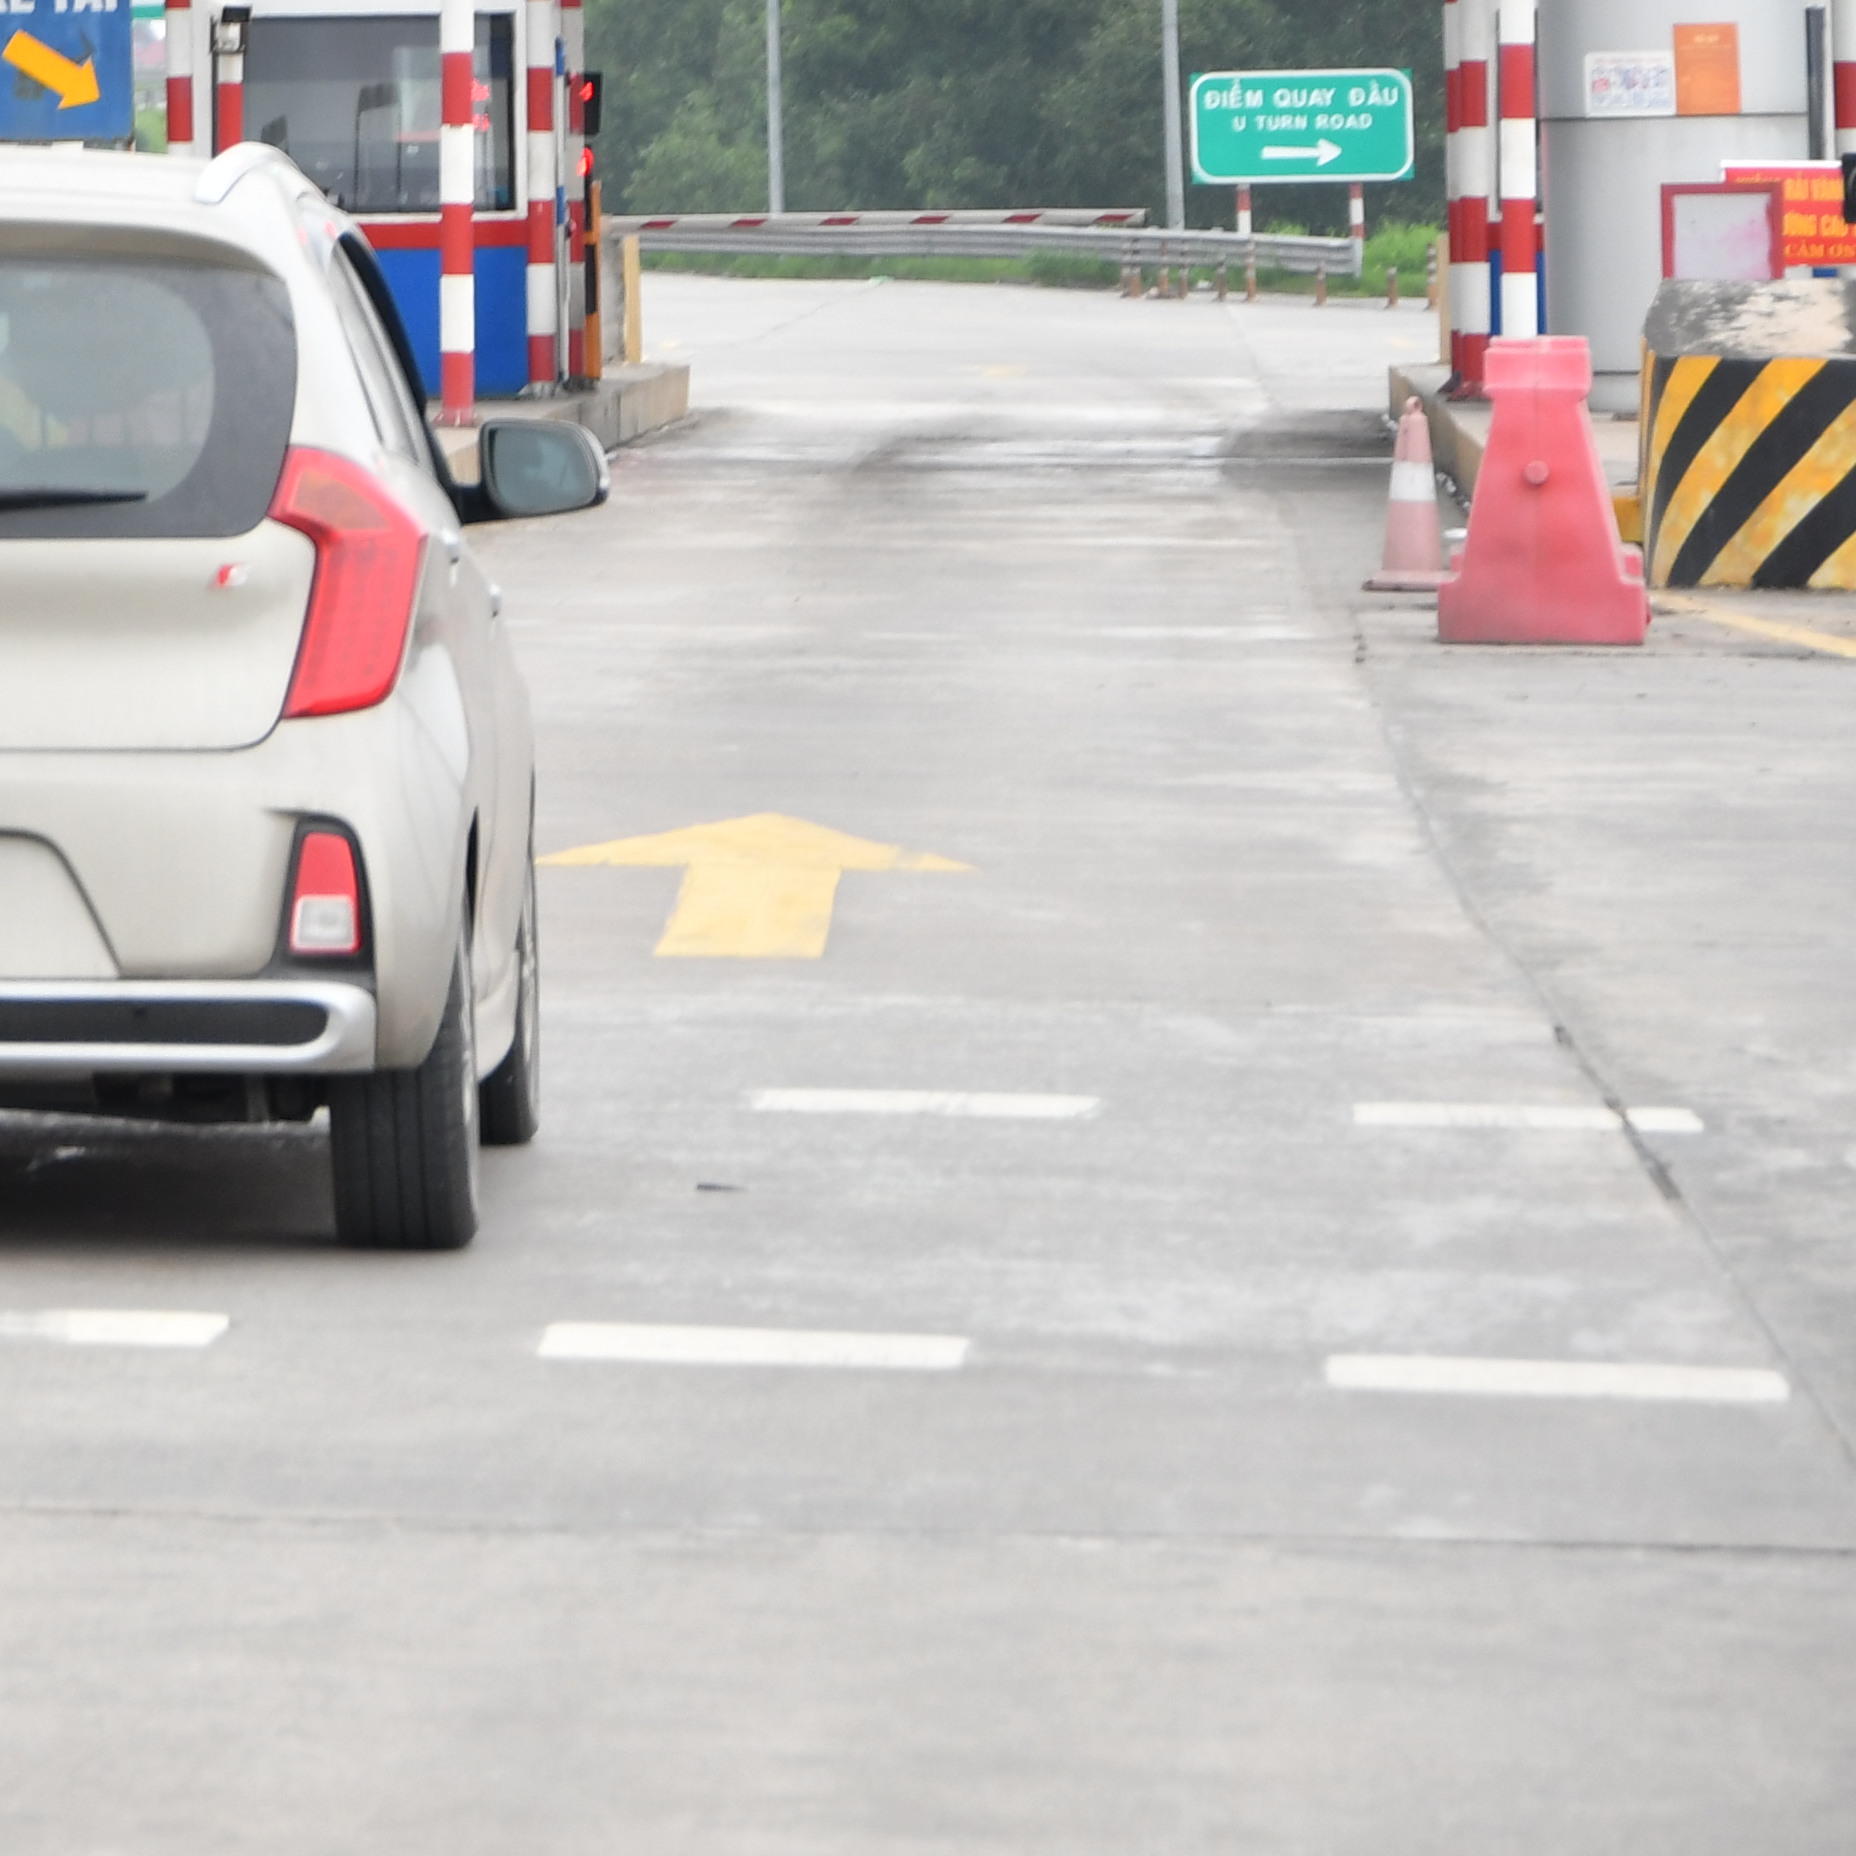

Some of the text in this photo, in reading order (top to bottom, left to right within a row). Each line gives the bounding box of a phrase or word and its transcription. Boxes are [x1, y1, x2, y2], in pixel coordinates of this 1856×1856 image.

[1204, 79, 1399, 109] ĐIỂM QUAY ĐẦU
[1232, 113, 1374, 132] U TURN ROAD
